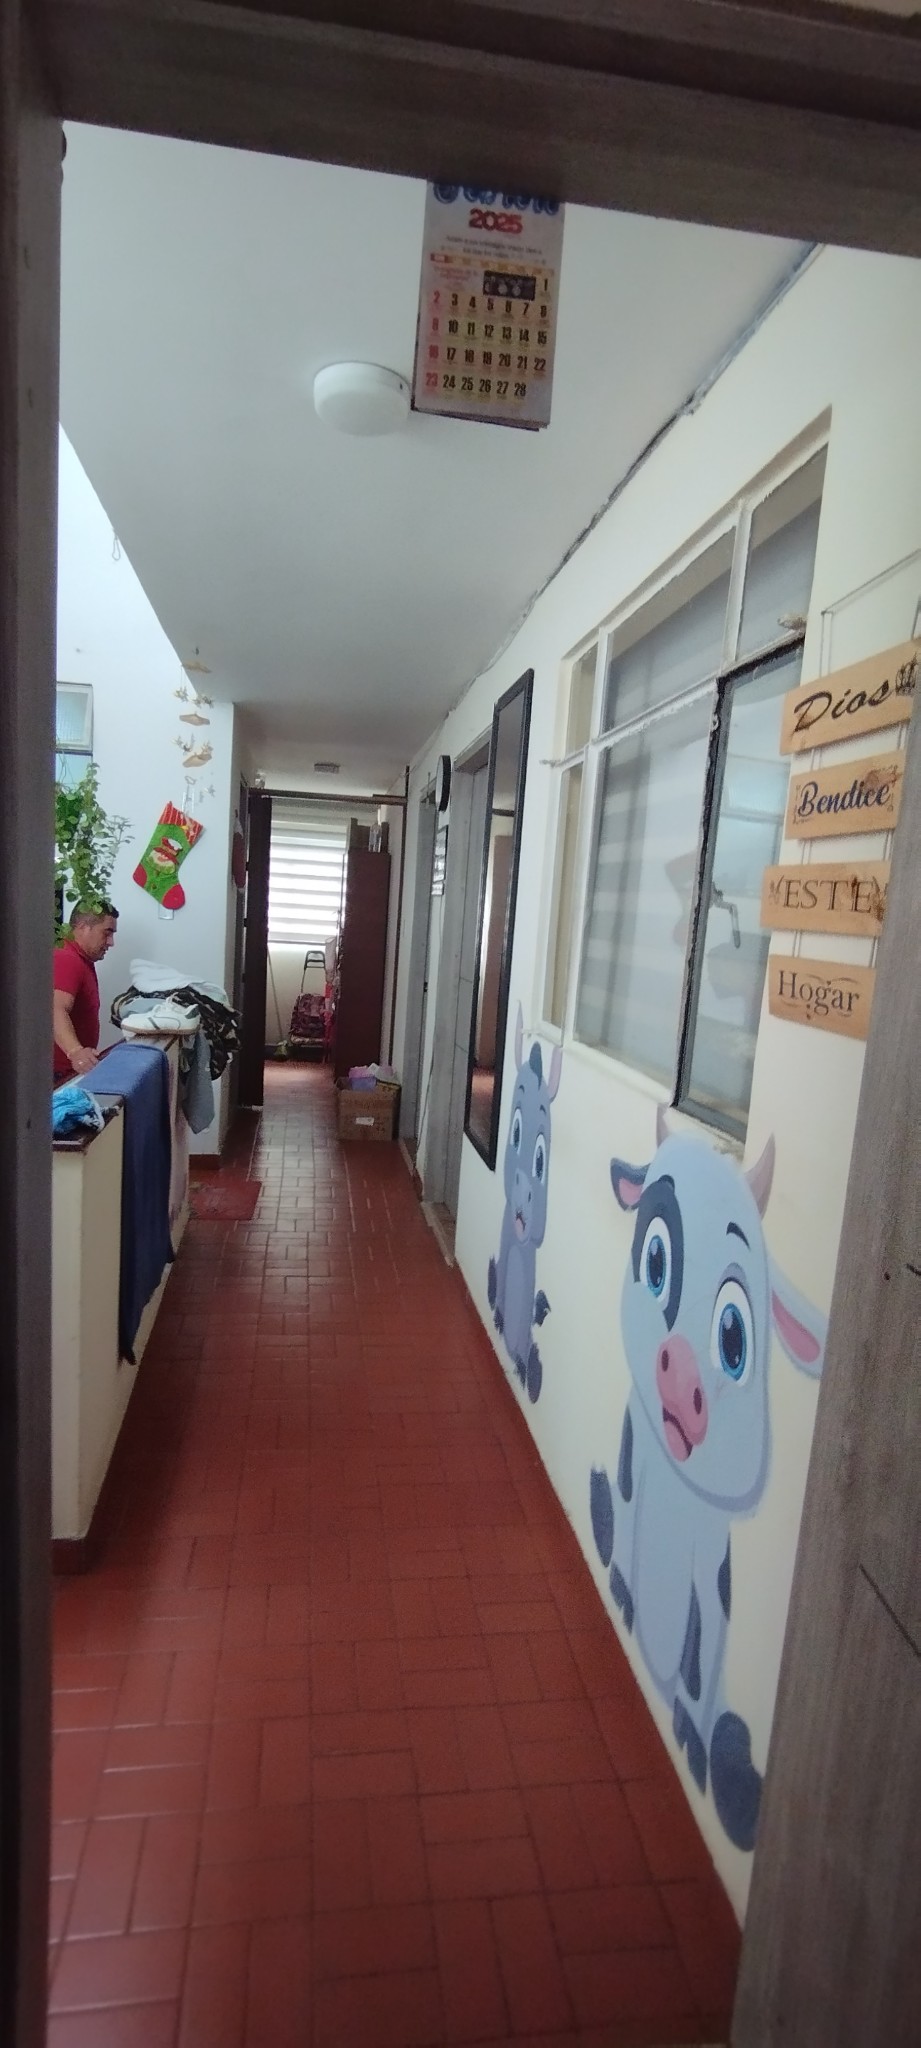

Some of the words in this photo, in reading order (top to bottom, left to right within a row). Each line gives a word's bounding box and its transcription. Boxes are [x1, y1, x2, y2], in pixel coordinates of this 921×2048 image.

[469, 208, 523, 234] 2025
[433, 290, 441, 304] 2
[451, 293, 458, 306] 3
[469, 296, 476, 308] 4
[487, 299, 494, 311] 5
[523, 303, 529, 316] 7
[448, 319, 458, 333] 10
[468, 322, 475, 336] 11
[484, 324, 494, 338] 12
[502, 326, 512, 340] 13
[519, 328, 529, 342] 14
[537, 330, 547, 345] 15
[446, 347, 456, 361] 17
[465, 350, 474, 363] 18
[482, 351, 492, 365] 19
[499, 353, 511, 367] 20
[517, 355, 527, 370] 21
[534, 357, 546, 372] 22
[426, 373, 438, 387] 23
[443, 374, 456, 389] 24
[461, 377, 473, 391] 25
[479, 379, 491, 393] 26
[497, 381, 509, 395] 27
[514, 382, 526, 397] 28
[792, 680, 889, 734] Dios
[798, 780, 890, 817] Bendice
[783, 878, 875, 914] ESTE
[778, 970, 860, 1016] Hogar
